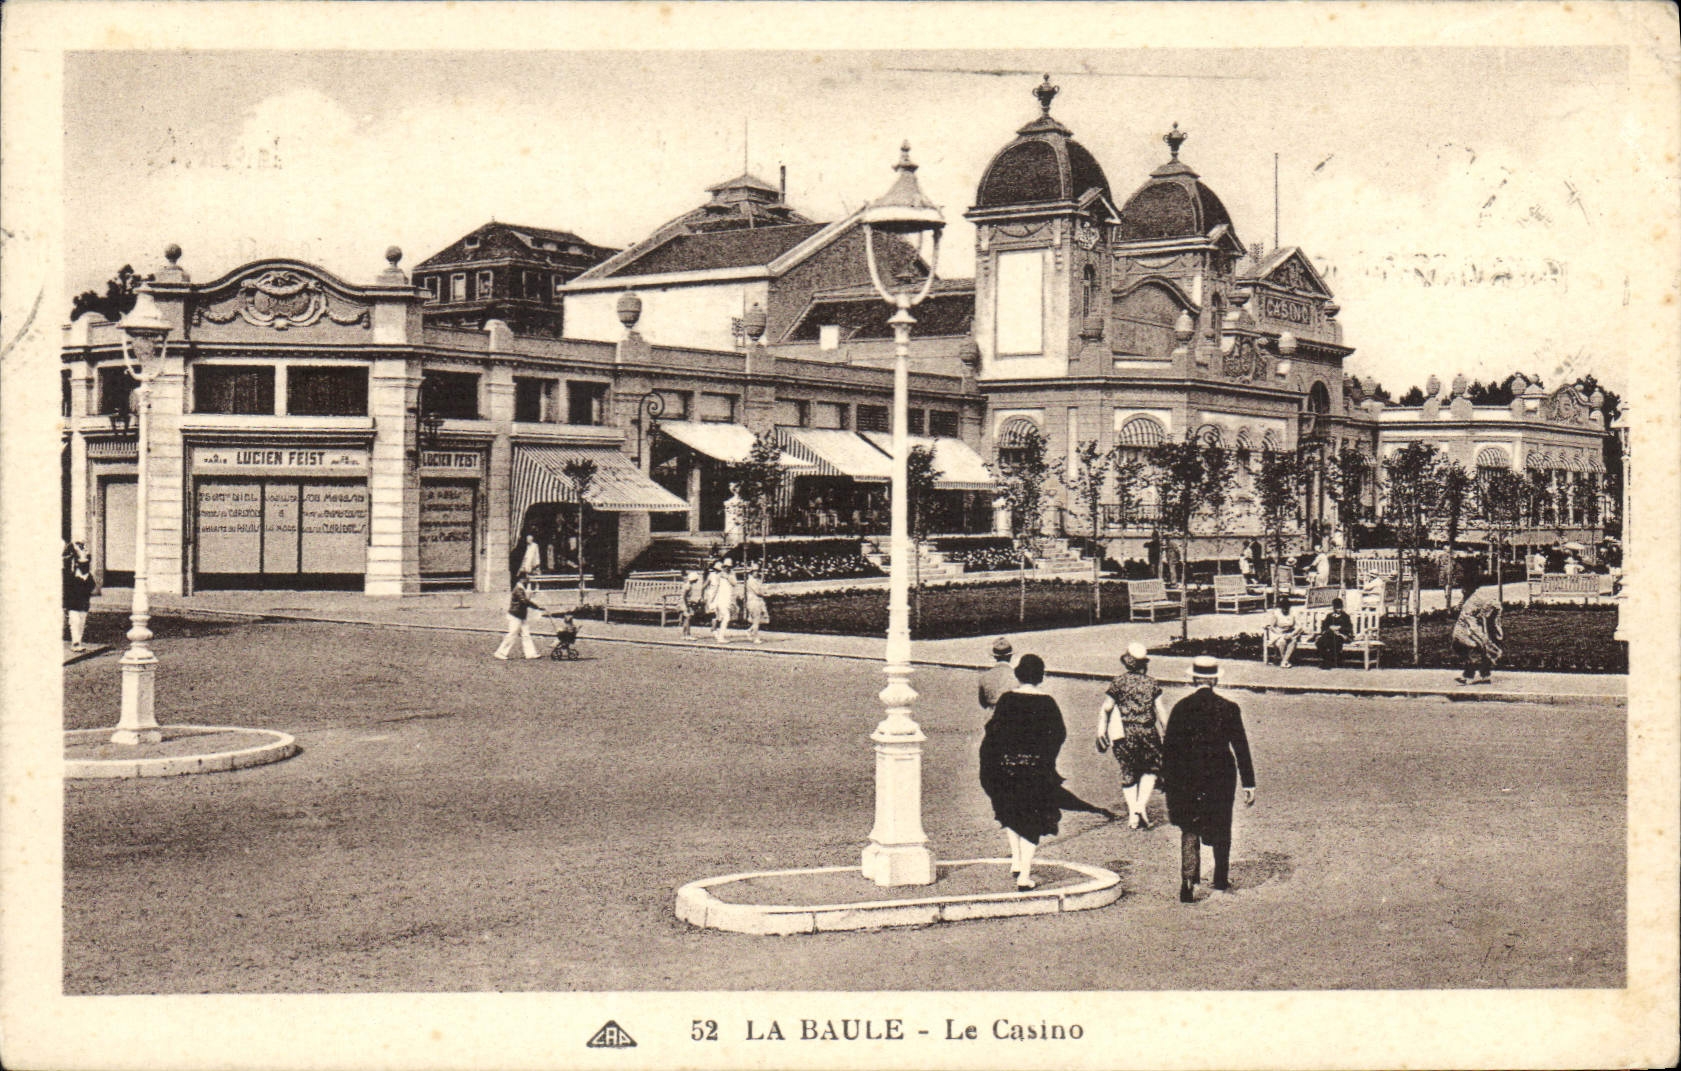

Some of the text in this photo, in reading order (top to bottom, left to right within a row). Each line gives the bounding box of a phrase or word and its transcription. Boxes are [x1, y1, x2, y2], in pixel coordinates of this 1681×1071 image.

[1267, 298, 1308, 321] CASINO
[236, 451, 283, 465] LUCIEN
[288, 451, 325, 466] FEIST
[423, 453, 478, 468] LUCIEN FEIST
